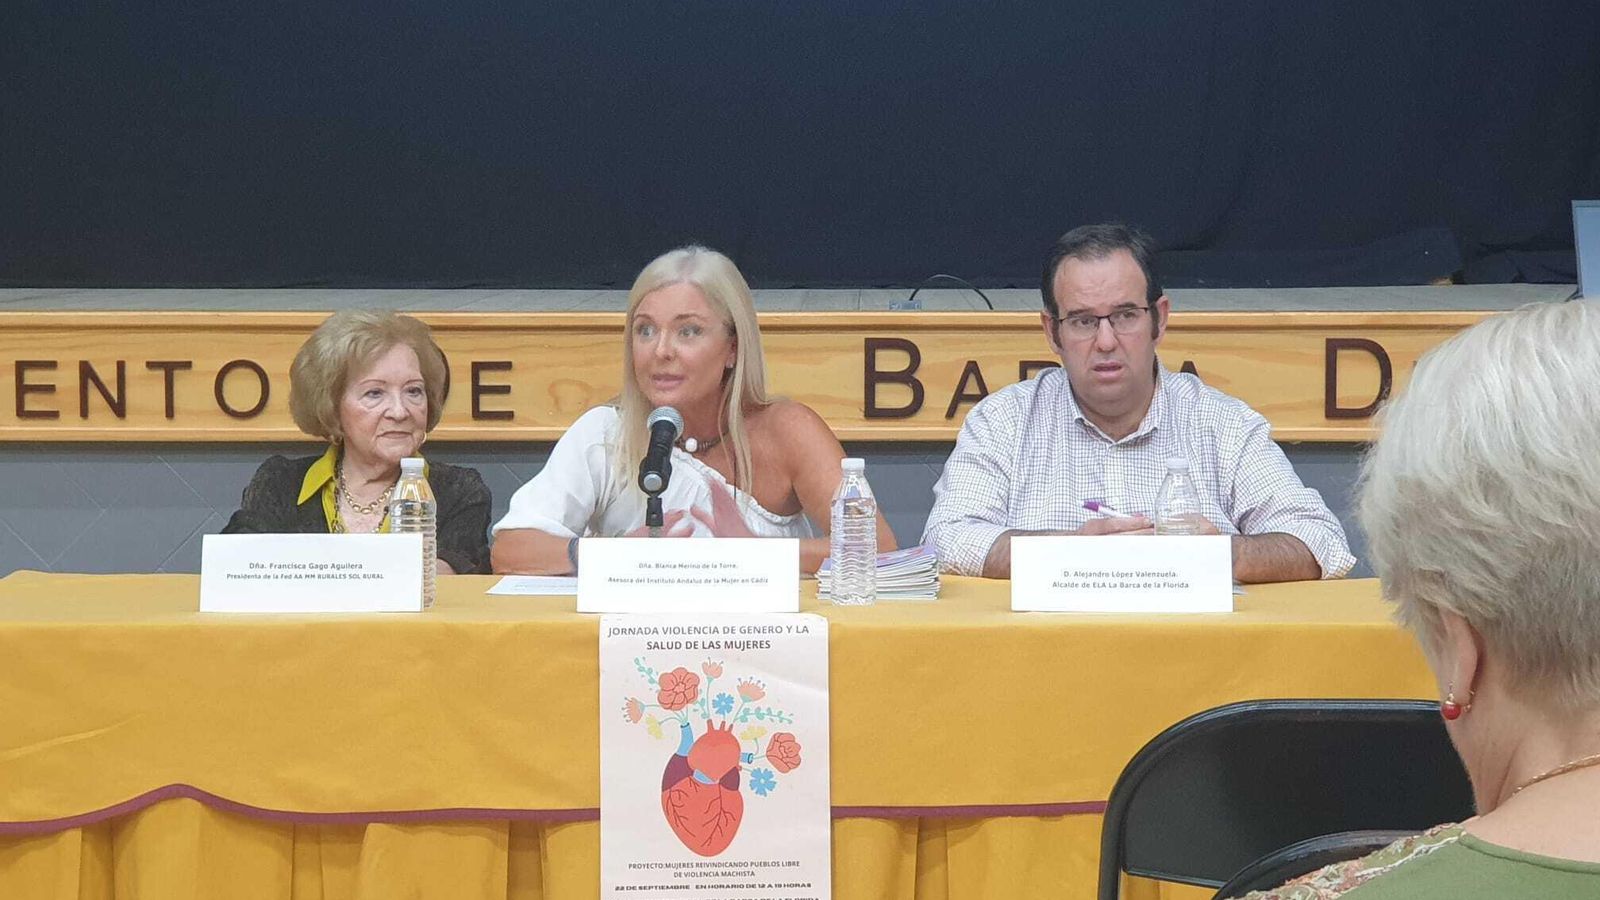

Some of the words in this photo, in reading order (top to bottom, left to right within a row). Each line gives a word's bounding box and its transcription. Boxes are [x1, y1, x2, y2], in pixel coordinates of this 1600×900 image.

[249, 562, 267, 570] Dña.
[269, 562, 307, 570] Francisca
[308, 562, 329, 571] Gago
[330, 562, 363, 571] Aguilera
[1063, 570, 1072, 578] D.
[1073, 570, 1110, 580] Alejandro
[1111, 570, 1134, 579] López
[647, 577, 676, 585] Instituto
[721, 577, 740, 585] Mujer
[1052, 581, 1080, 589] Alcalde
[1081, 581, 1091, 589] de
[1092, 581, 1107, 589] ELA
[1108, 581, 1118, 589] La
[1119, 581, 1141, 589] Barca
[1142, 581, 1152, 589] de
[1153, 581, 1161, 589] la
[1162, 581, 1190, 589] Florida
[607, 626, 660, 638] JORNADA
[662, 625, 720, 636] VIOLENCIA
[722, 625, 737, 635] DE
[738, 625, 784, 635] GENERO
[785, 625, 794, 634] Y
[795, 624, 810, 634] LA
[646, 641, 682, 650] SALUD
[685, 640, 699, 650] DE
[701, 640, 721, 650] LAS
[724, 640, 771, 652] MUJERES
[695, 861, 749, 869] REIVINDICANDO
[781, 860, 801, 868] LIBRE
[720, 870, 756, 878] MACHISTA
